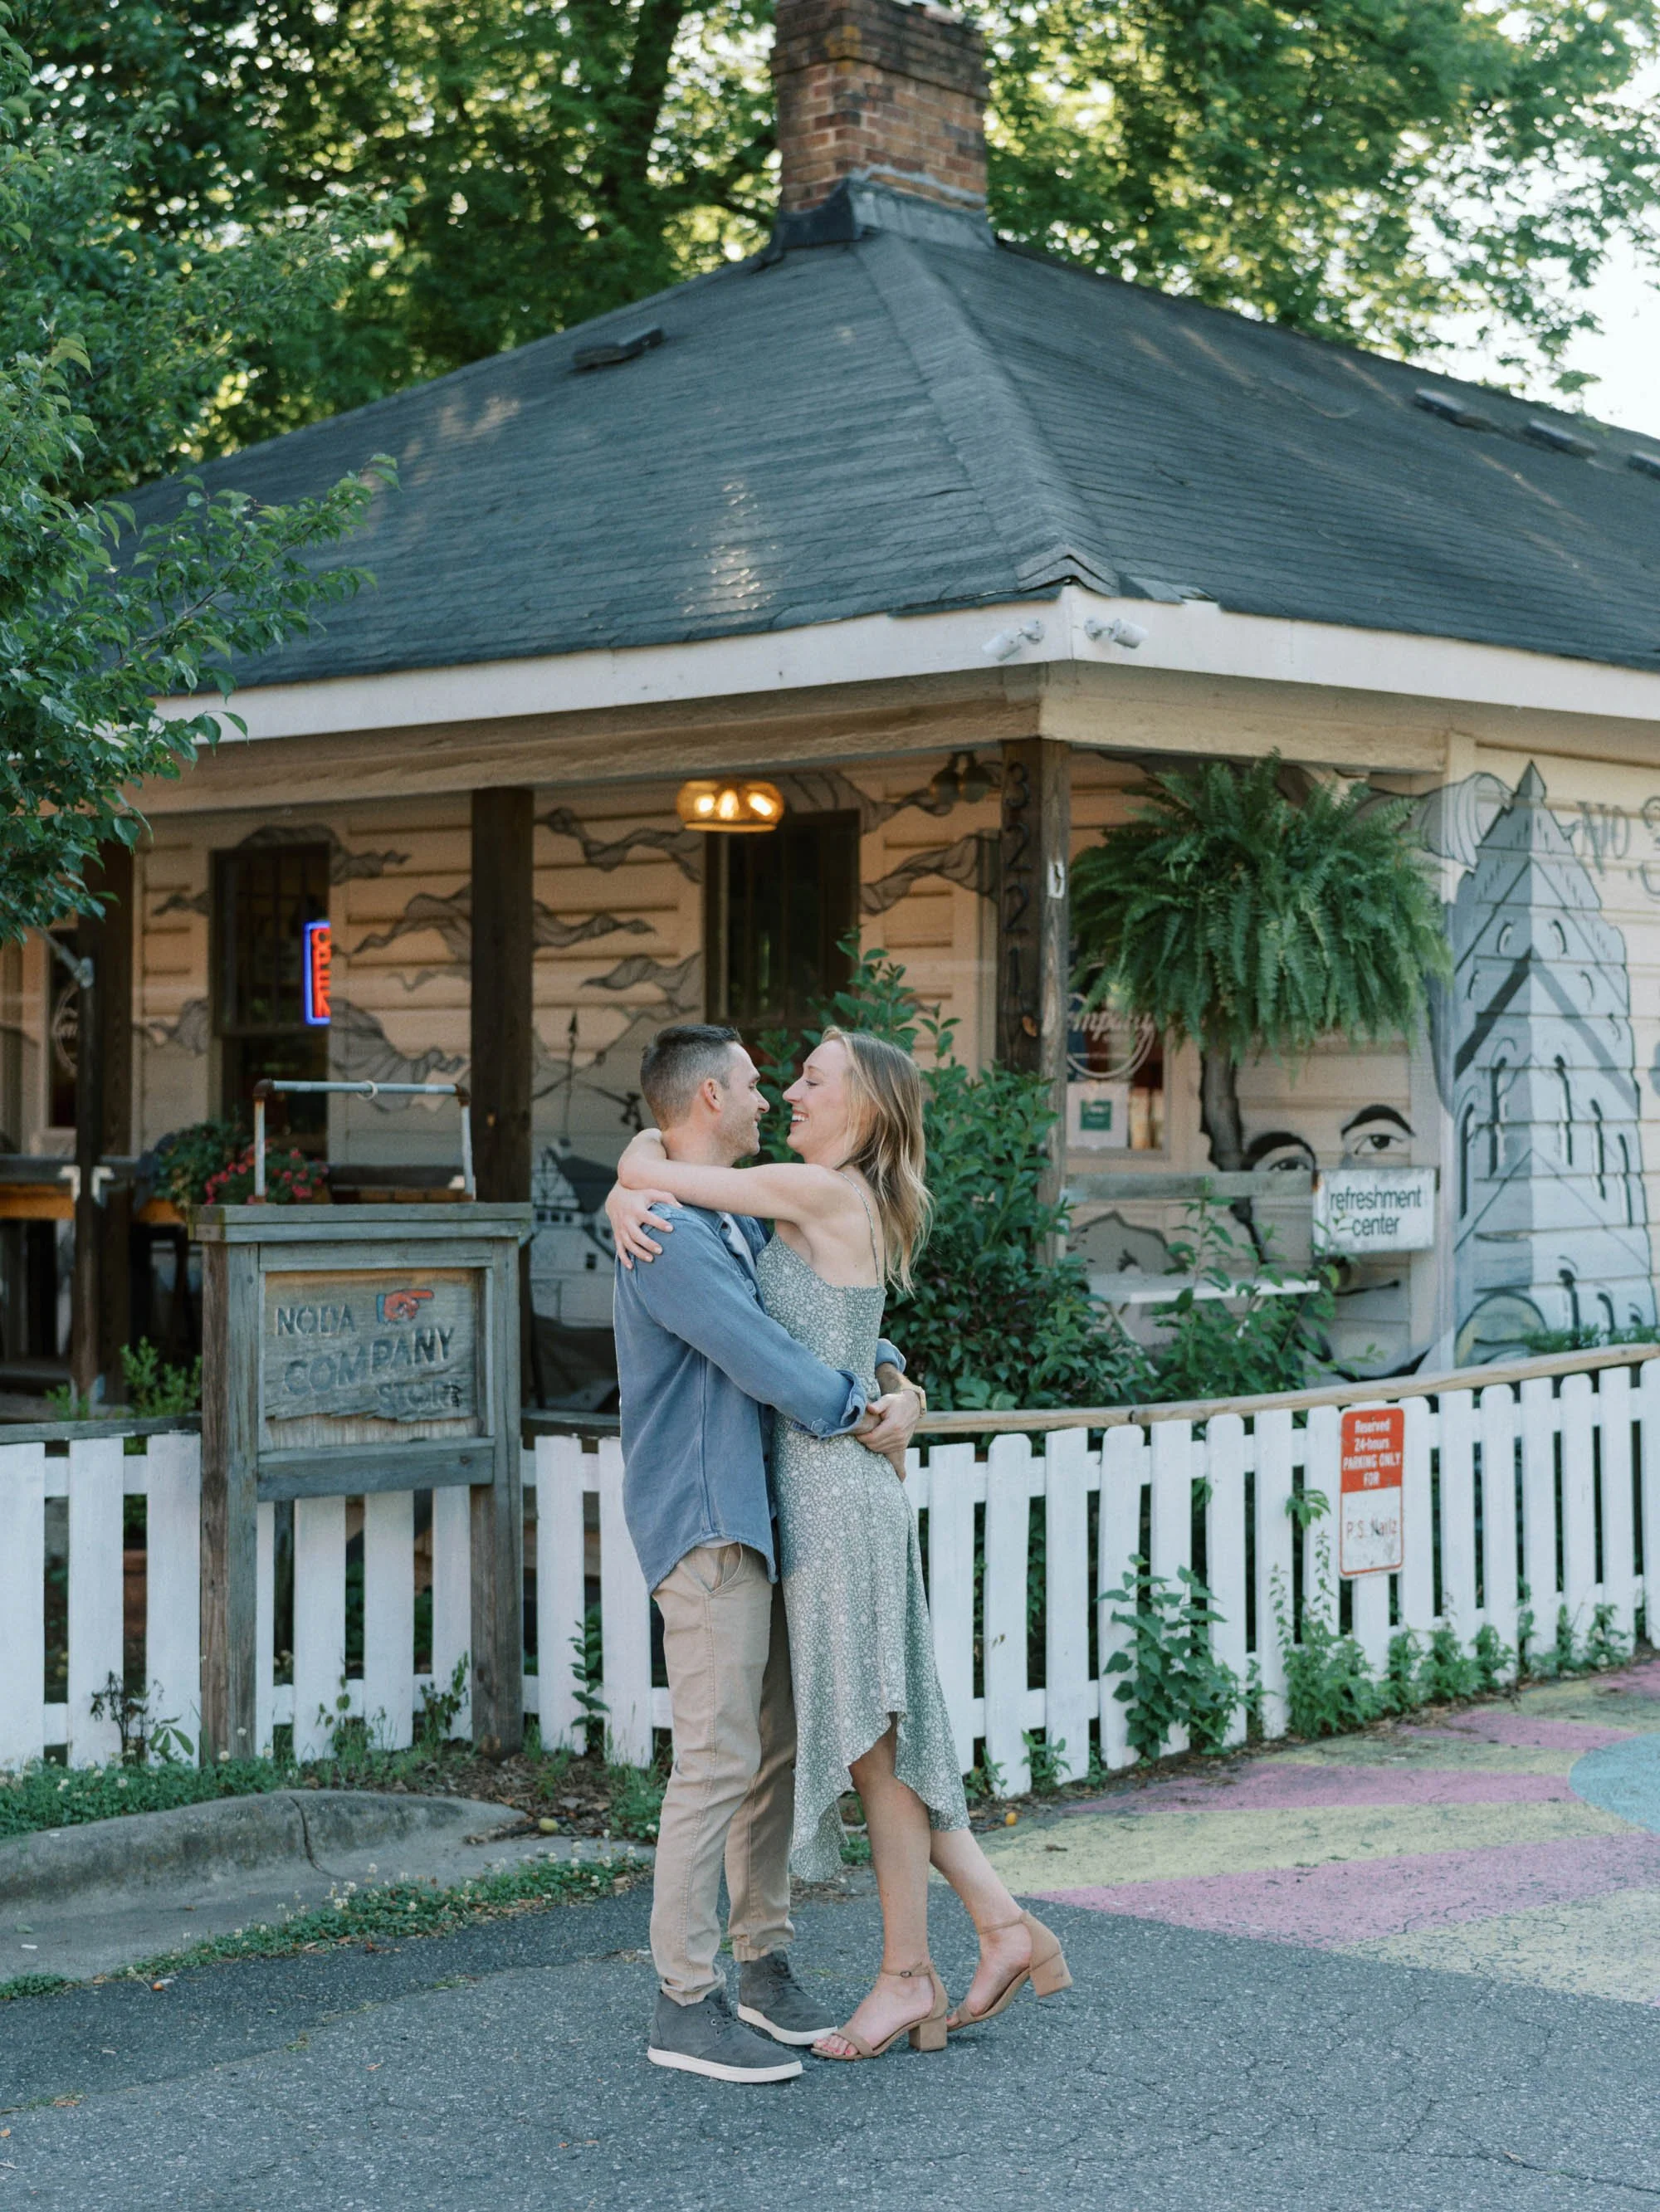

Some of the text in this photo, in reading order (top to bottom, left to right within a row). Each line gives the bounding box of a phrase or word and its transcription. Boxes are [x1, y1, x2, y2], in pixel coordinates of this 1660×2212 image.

[1003, 761, 1032, 997] 3221
[1330, 1184, 1422, 1211] refreshment
[1351, 1213, 1401, 1237] center
[275, 1304, 357, 1336] NODA
[284, 1326, 455, 1396] COMPANY
[1355, 1419, 1391, 1434] Reserved
[1343, 1452, 1401, 1471] PARKING ONLY
[1363, 1471, 1381, 1487] FOR
